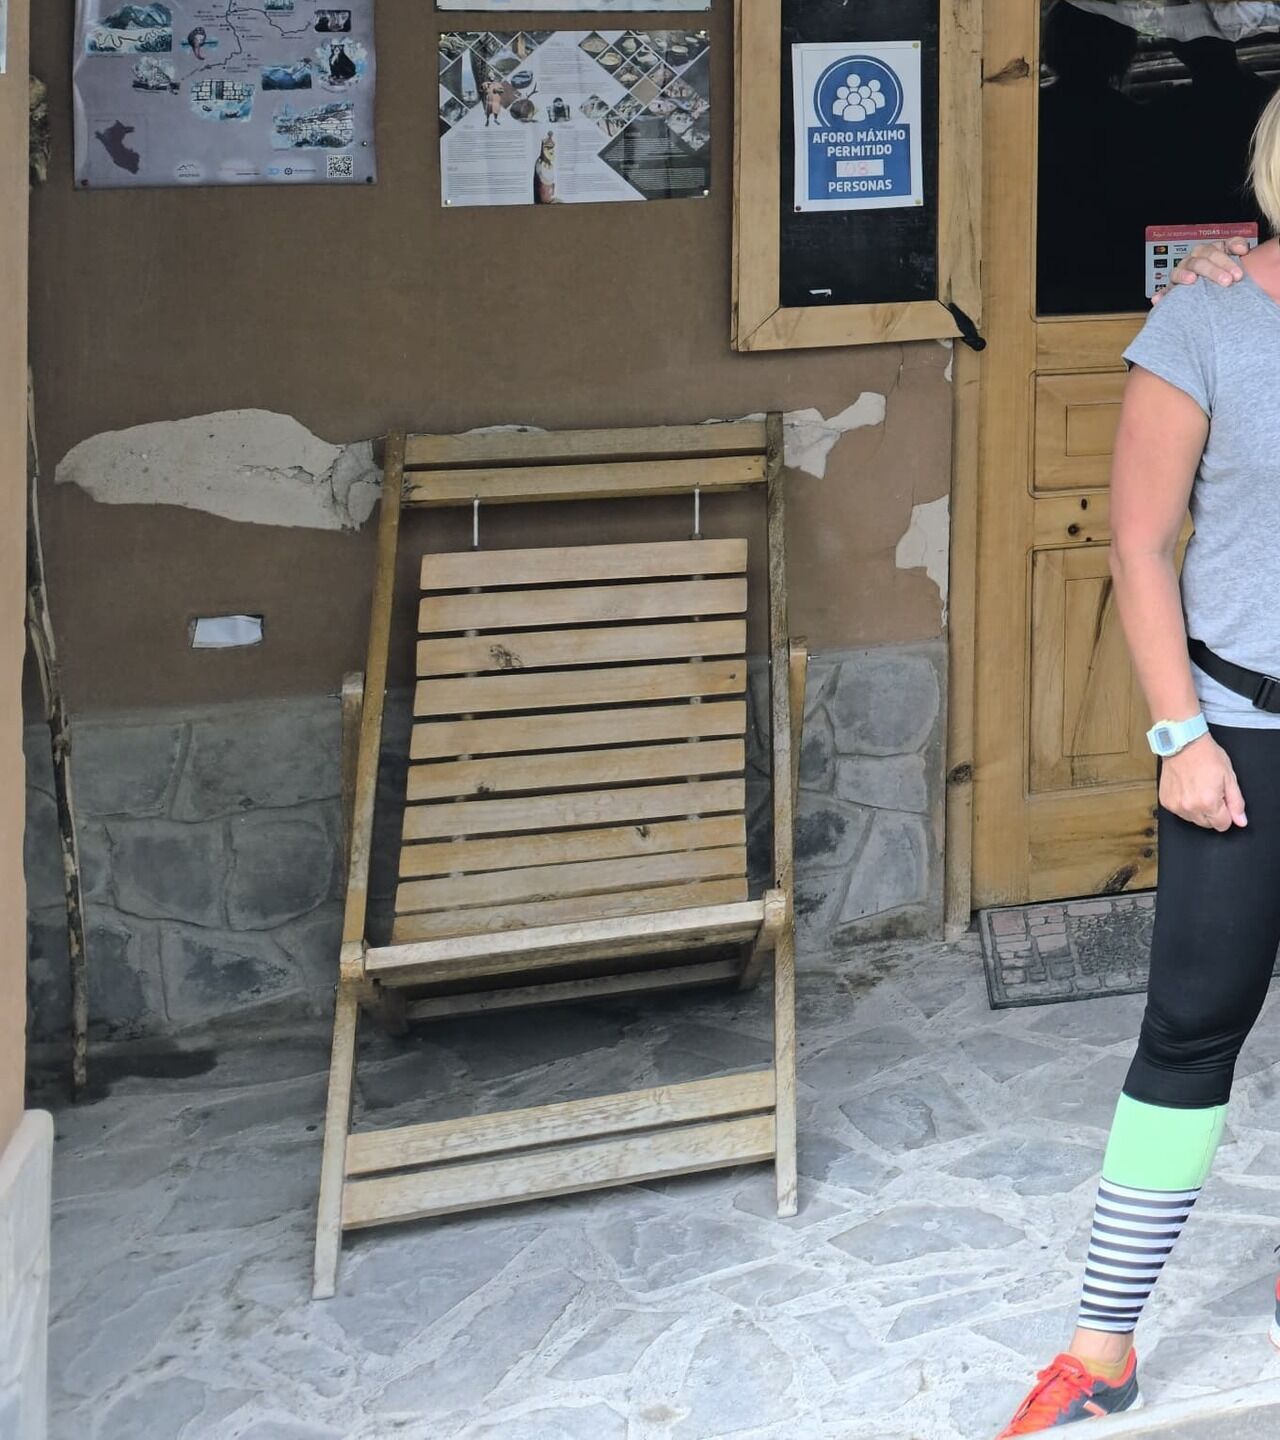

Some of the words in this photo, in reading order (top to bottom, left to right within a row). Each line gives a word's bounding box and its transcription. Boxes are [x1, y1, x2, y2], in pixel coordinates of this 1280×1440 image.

[812, 132, 854, 144] AFORO
[857, 128, 906, 142] MÁXIMO
[827, 144, 892, 157] PERMITIDO
[828, 179, 893, 192] PERSONAS
